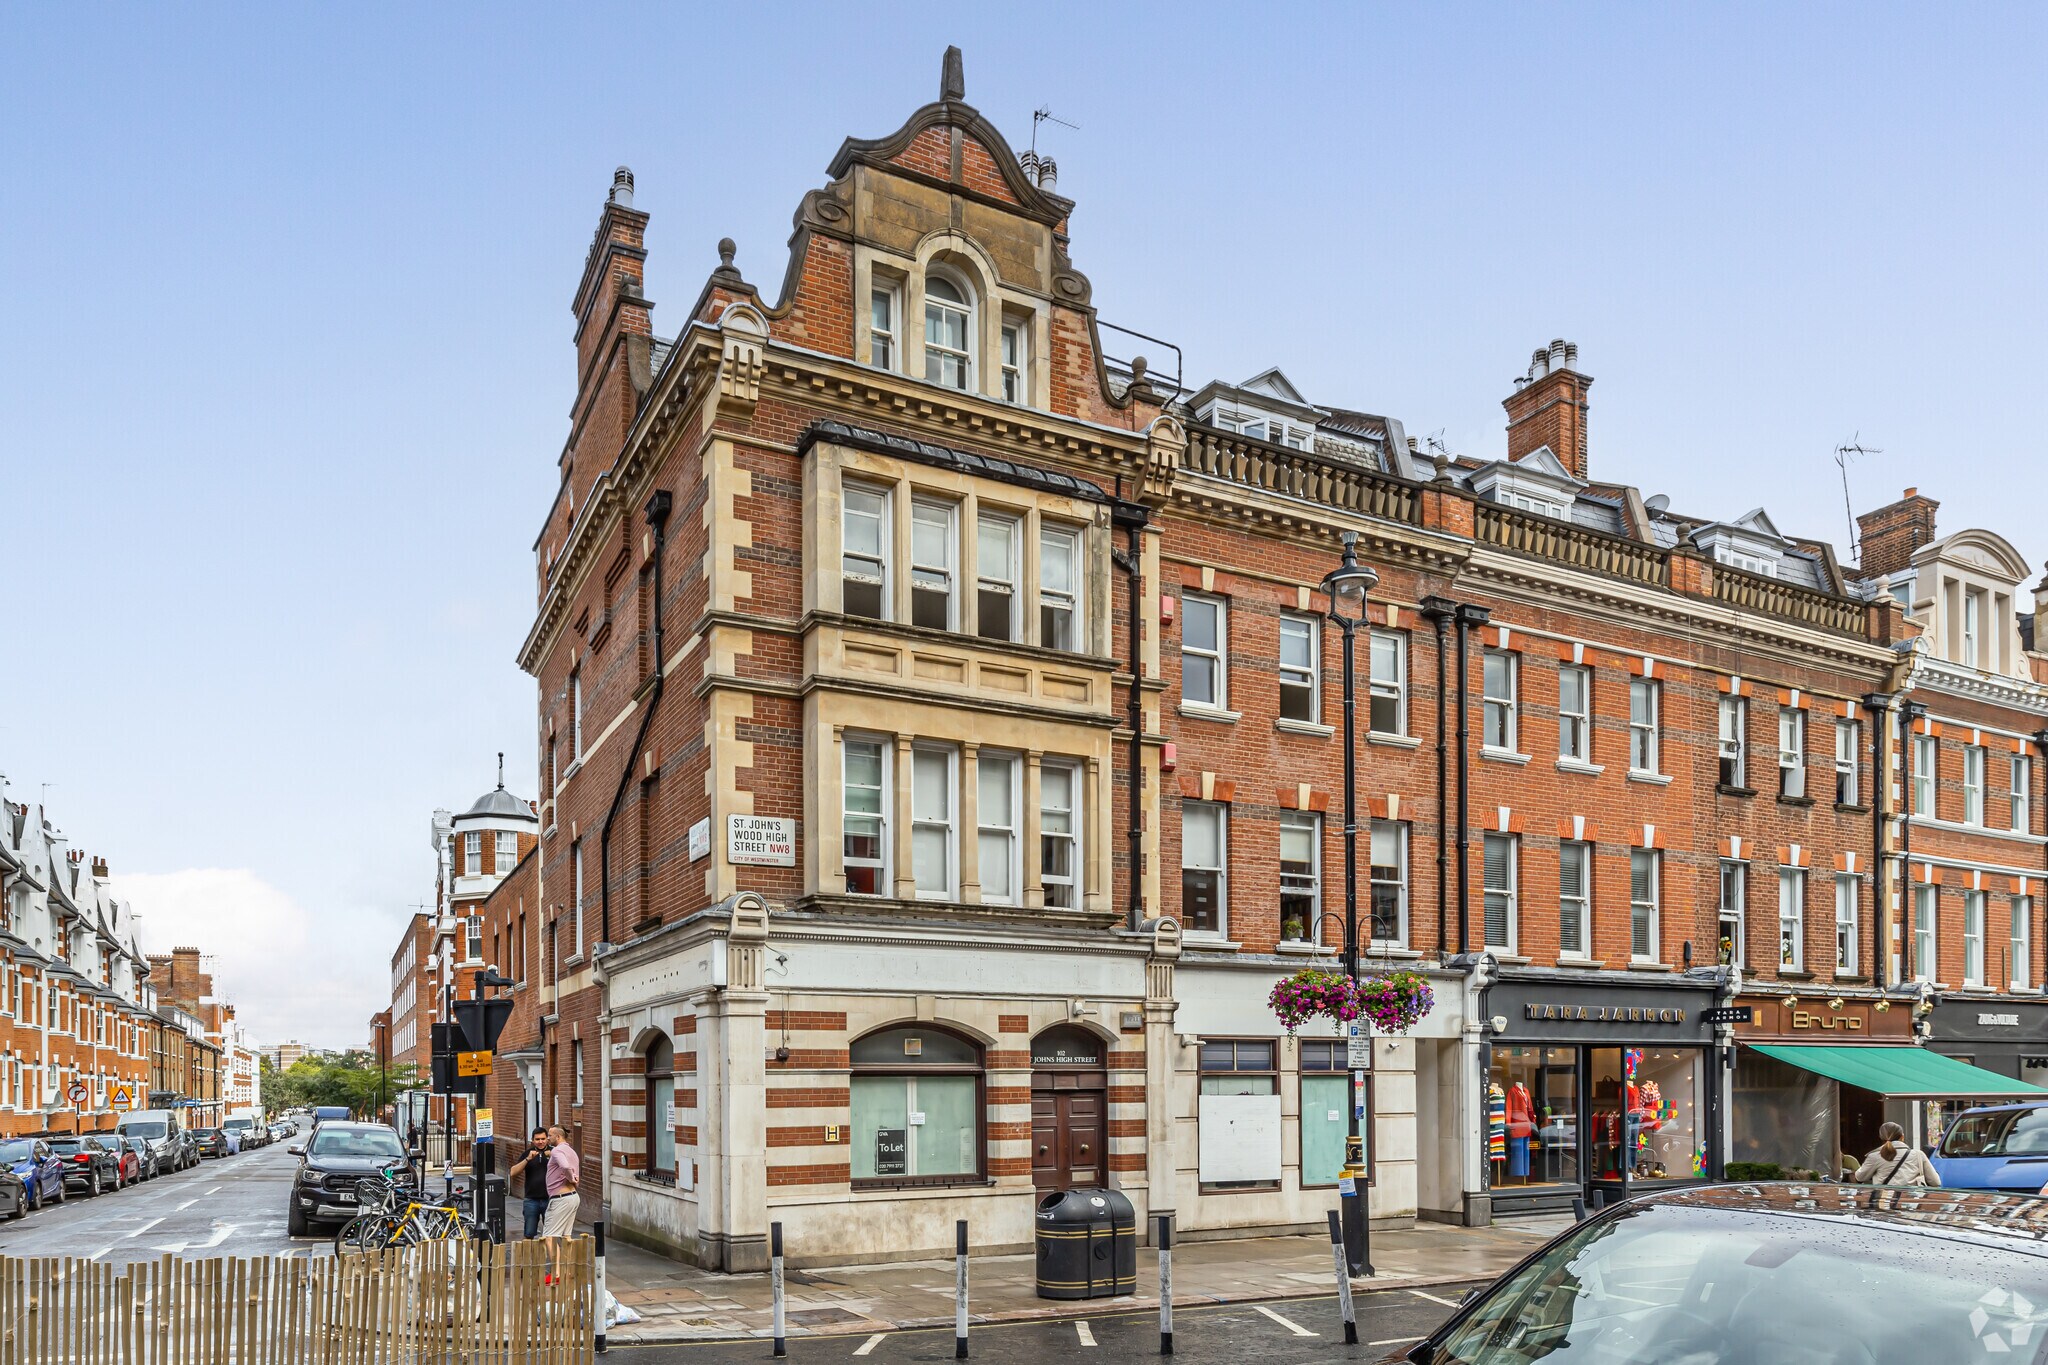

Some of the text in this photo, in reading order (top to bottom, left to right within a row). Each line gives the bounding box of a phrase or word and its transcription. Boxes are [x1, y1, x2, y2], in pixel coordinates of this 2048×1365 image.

[734, 818, 780, 830] ST. JOHN'S
[734, 830, 786, 842] WOOD HIGH
[734, 842, 790, 854] STREET NW8
[1528, 1004, 1686, 1022] TARA JARMON
[1794, 1011, 1862, 1028] Bruno
[828, 1126, 837, 1140] H
[879, 1144, 904, 1152] To Let
